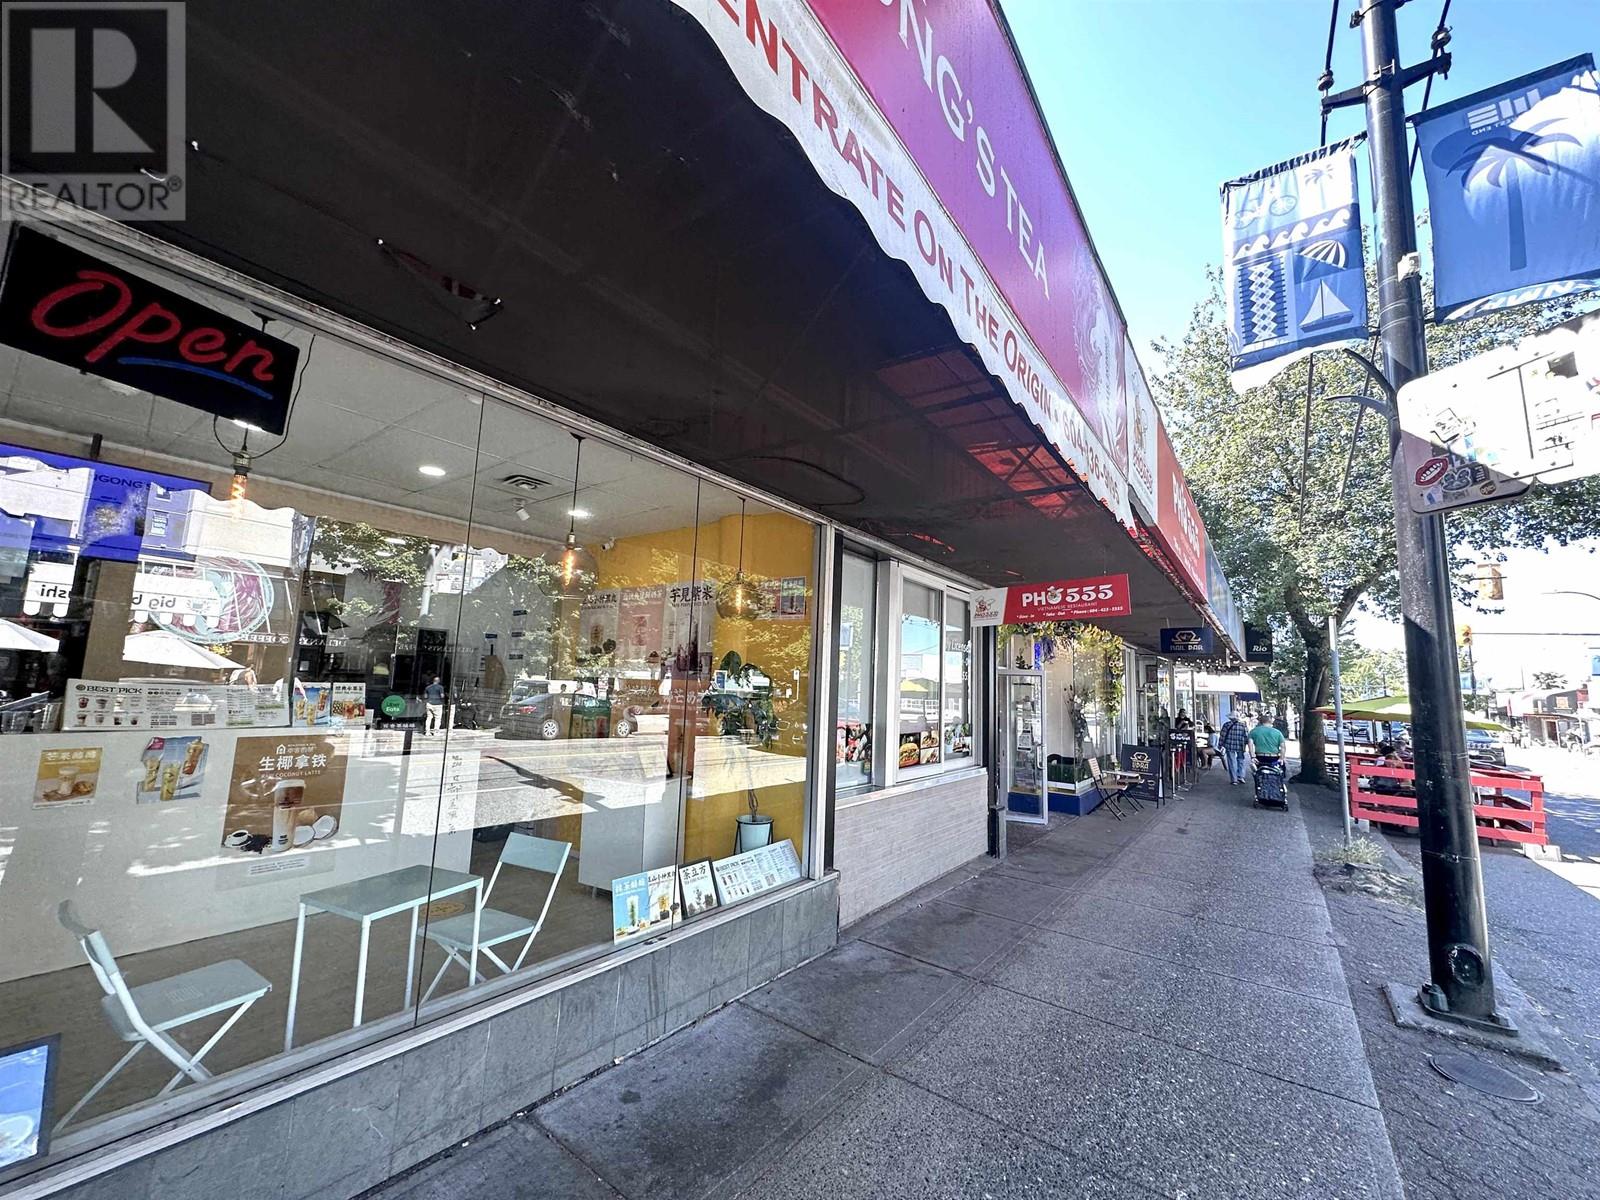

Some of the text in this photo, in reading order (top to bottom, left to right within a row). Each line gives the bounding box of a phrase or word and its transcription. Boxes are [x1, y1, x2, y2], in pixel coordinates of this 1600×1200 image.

[880, 0, 1050, 300] NG'S TEA
[914, 210, 953, 293] ON
[960, 266, 999, 354] THE
[1003, 329, 1052, 421] ORIGIN
[31, 270, 274, 381] Open
[1065, 584, 1114, 602] 555
[86, 685, 116, 694] BEST
[118, 686, 143, 695] PICK
[258, 753, 328, 772] 生椰拿铁
[682, 864, 706, 881] 茶立方
